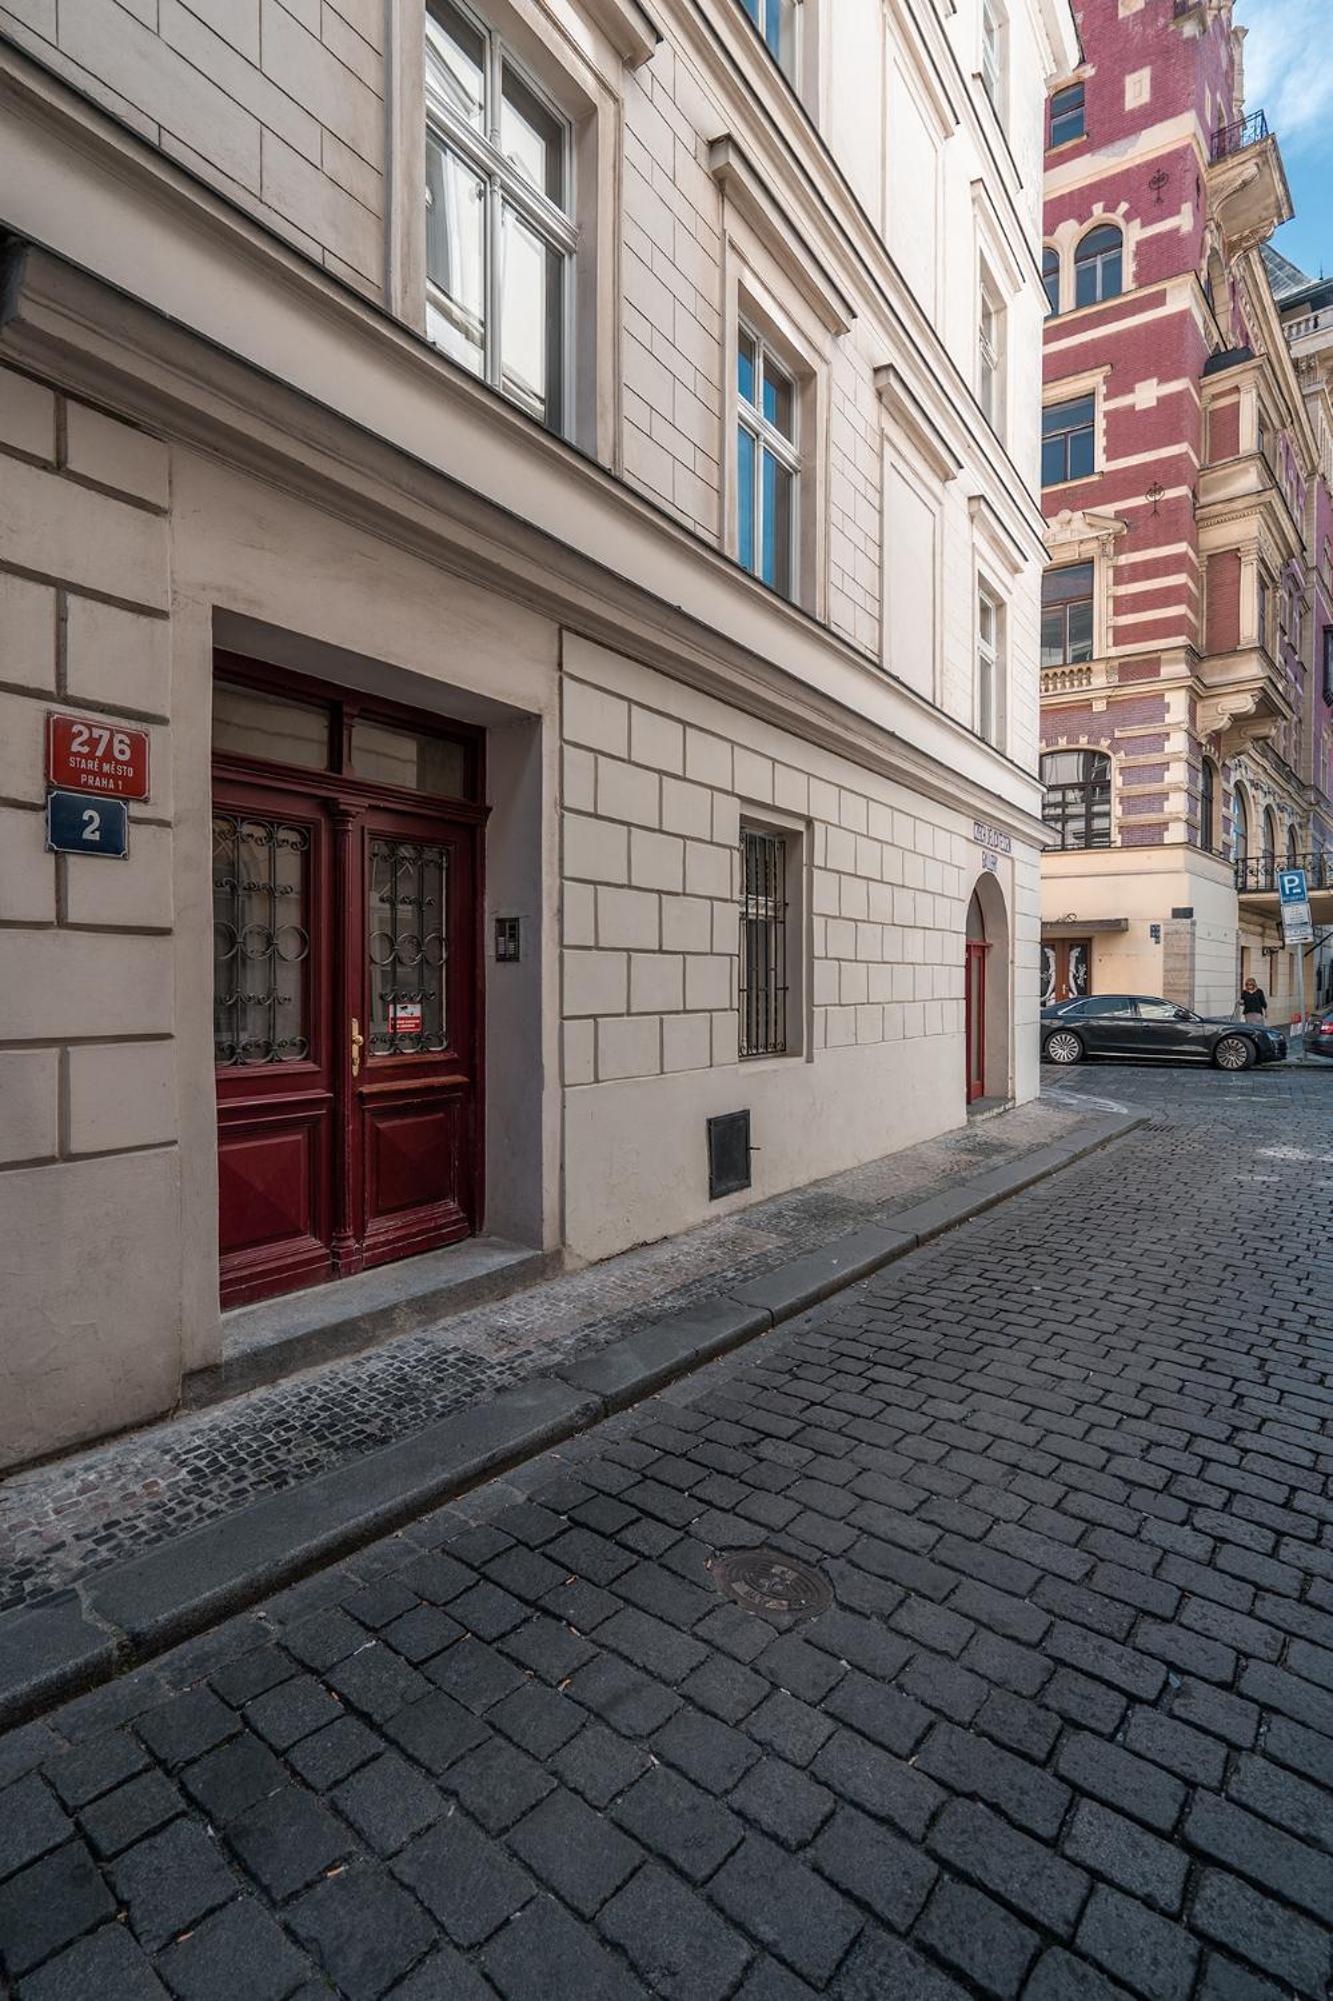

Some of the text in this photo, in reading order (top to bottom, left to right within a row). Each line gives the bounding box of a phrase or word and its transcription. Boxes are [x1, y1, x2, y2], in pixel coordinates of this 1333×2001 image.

[71, 724, 131, 760] 276
[69, 757, 133, 777] STARÉ MĚSTO
[81, 774, 122, 790] PRAHA 1
[82, 810, 100, 840] 2
[1283, 875, 1300, 894] P
